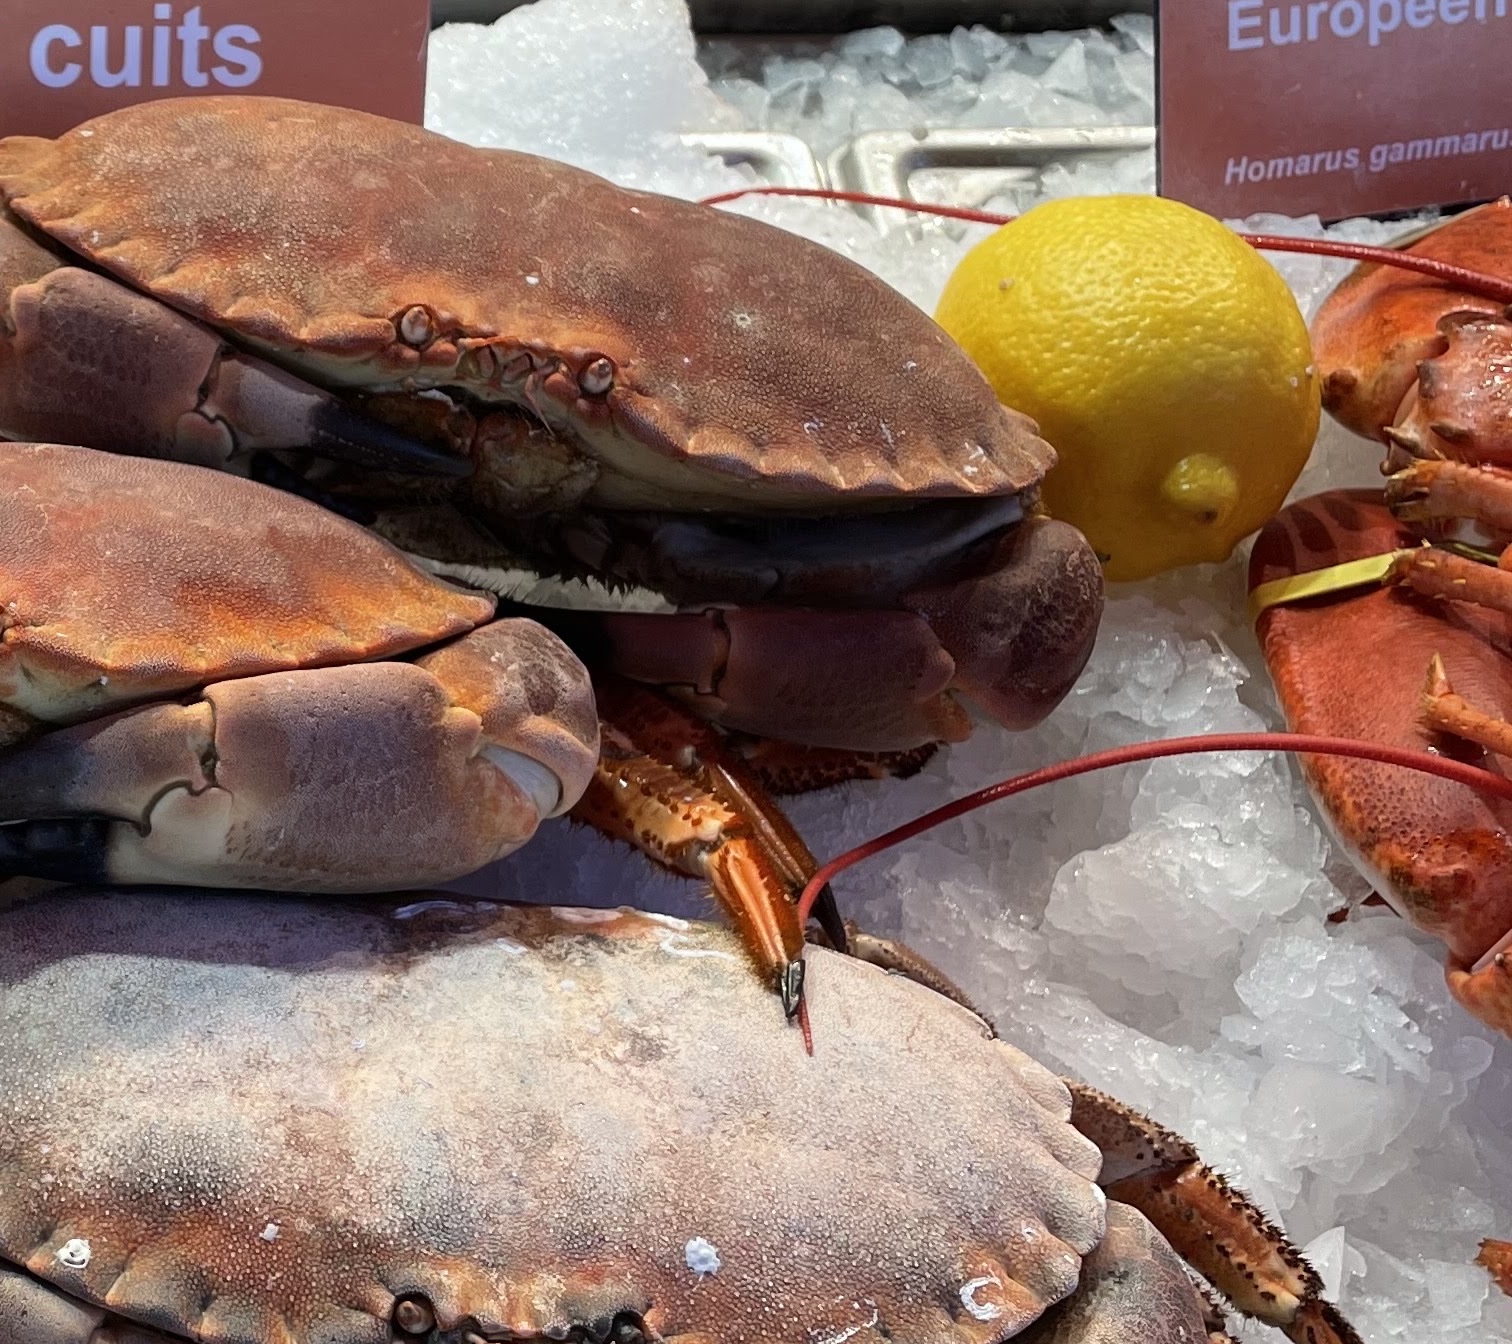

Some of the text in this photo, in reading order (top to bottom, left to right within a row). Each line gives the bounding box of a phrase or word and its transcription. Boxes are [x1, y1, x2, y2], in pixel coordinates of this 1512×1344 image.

[29, 3, 264, 88] cuits
[1224, 127, 1512, 185] Homarus gammaru
